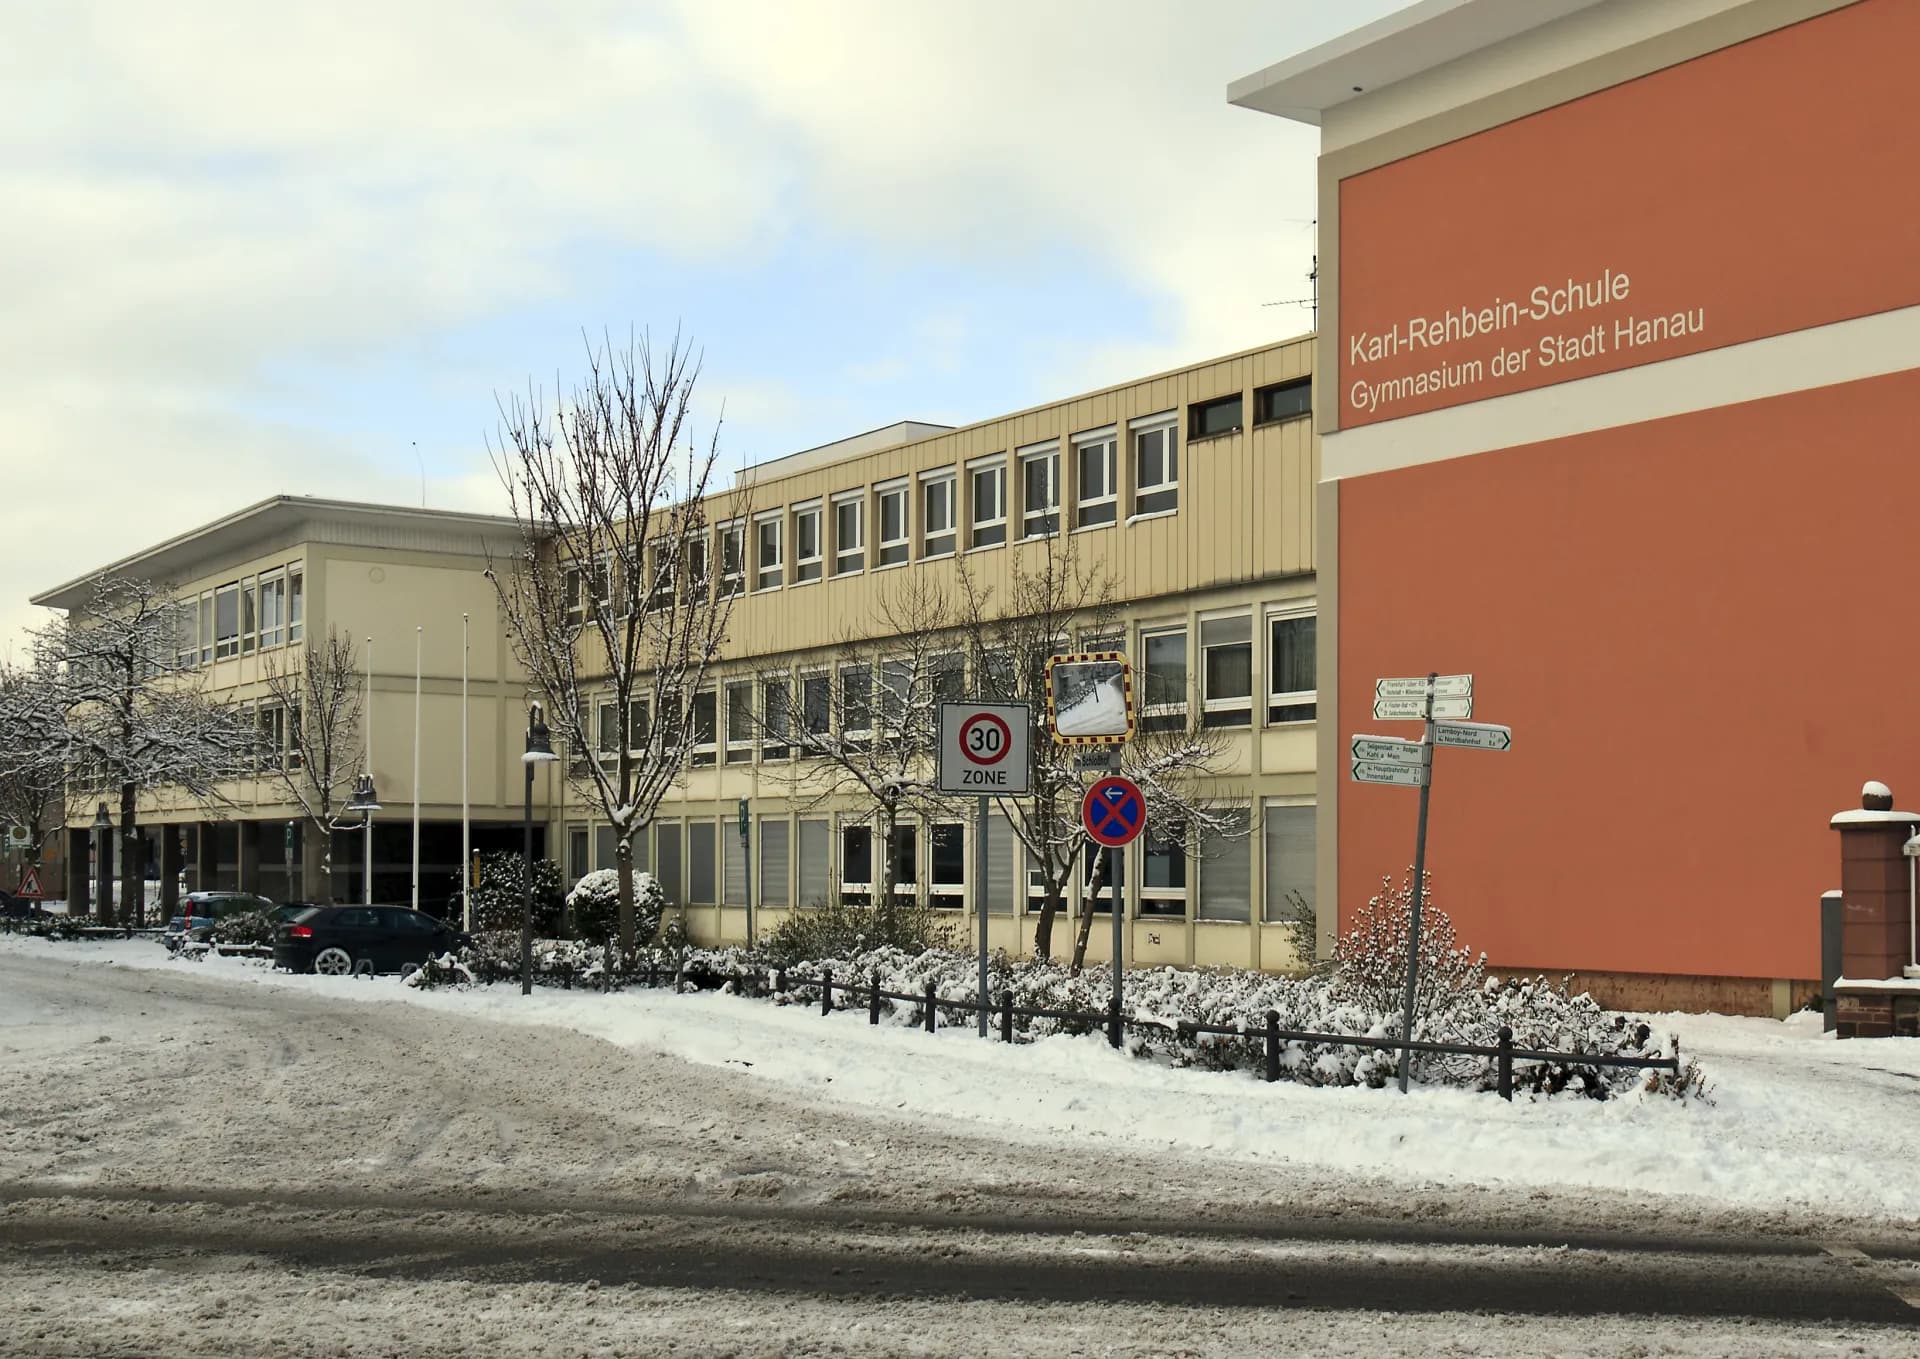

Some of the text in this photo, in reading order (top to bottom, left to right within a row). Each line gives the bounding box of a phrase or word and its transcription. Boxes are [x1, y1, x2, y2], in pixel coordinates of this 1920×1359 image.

[1350, 269, 1630, 366] Karl-Rehbein-Schule
[1350, 308, 1705, 413] Gymnasium der Stadt Hanau
[970, 727, 1000, 752] 30
[1438, 728, 1477, 737] Lamboy-Nord
[963, 770, 1007, 785] ZONE
[1374, 764, 1409, 774] Hauptbahnhof
